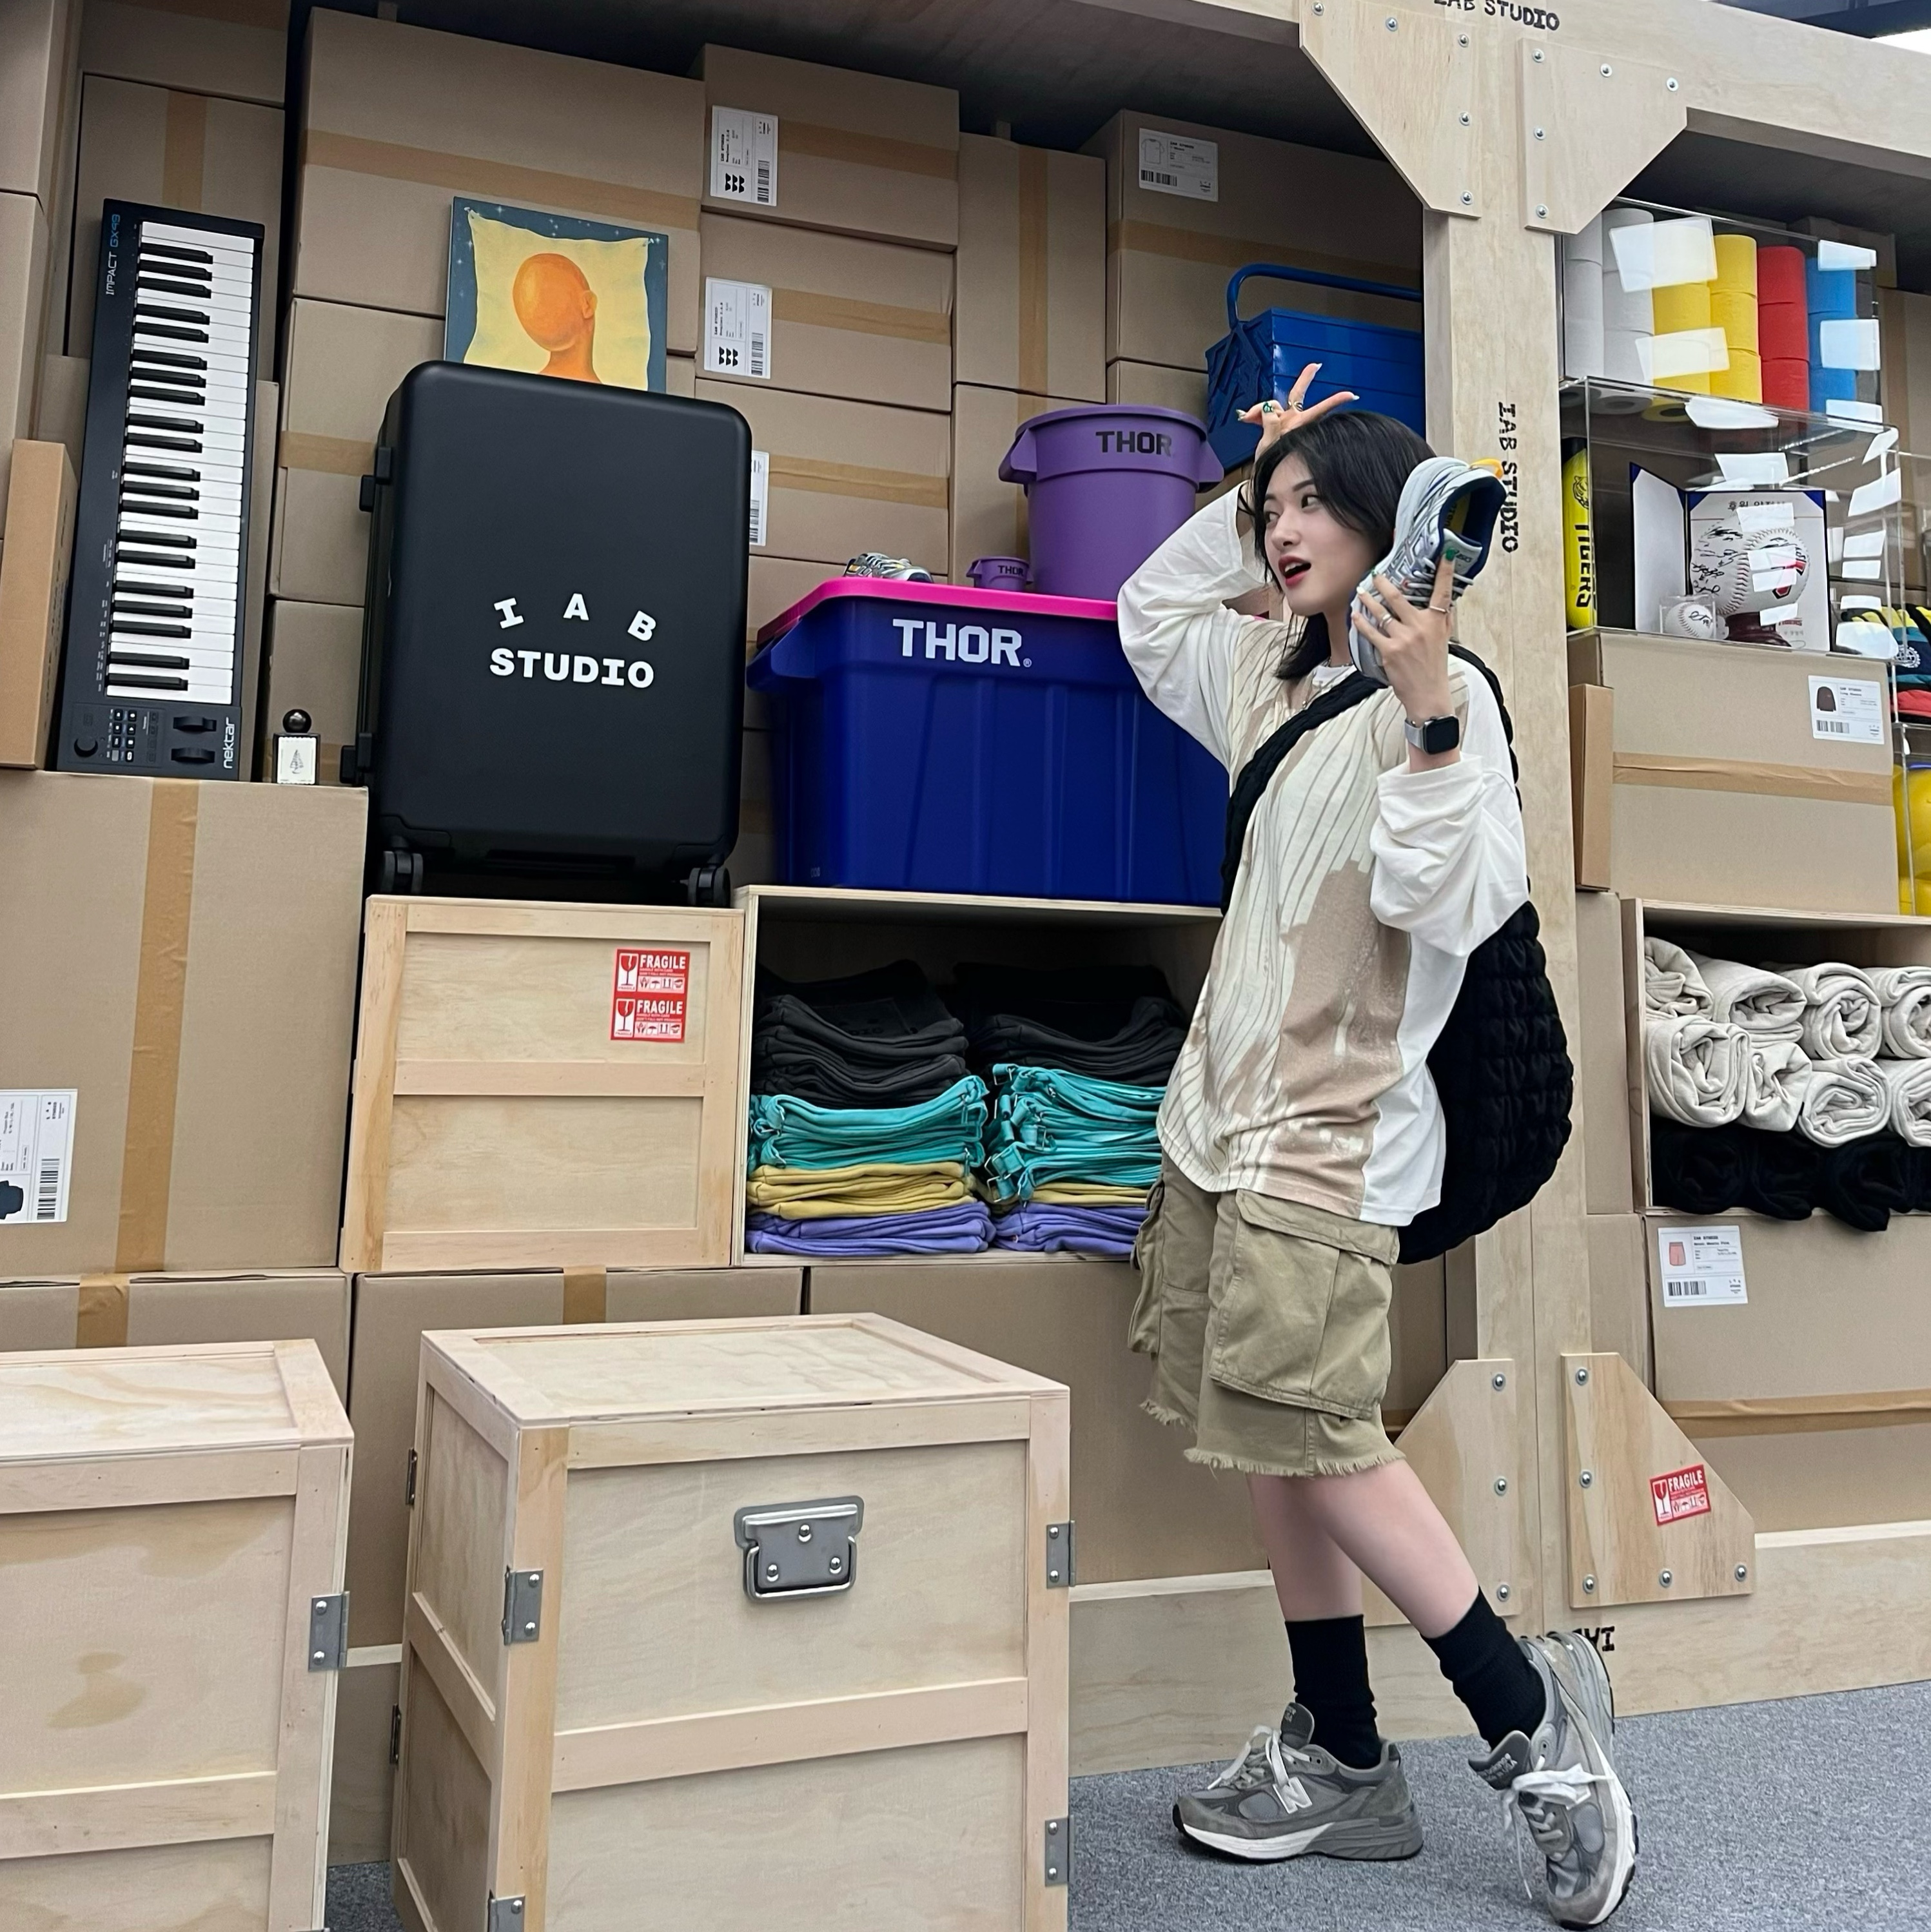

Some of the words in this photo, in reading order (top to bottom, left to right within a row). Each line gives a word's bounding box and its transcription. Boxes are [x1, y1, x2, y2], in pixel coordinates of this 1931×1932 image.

[1484, 0, 1560, 31] STUDIO
[110, 214, 121, 248] GX49
[106, 251, 117, 295] IMPACT
[1498, 401, 1517, 451] IAB
[1095, 430, 1172, 458] THOR
[1500, 460, 1518, 554] STUDIO
[997, 564, 1024, 578] THOR
[489, 647, 654, 688] STUDIO
[222, 716, 235, 769] nektar
[640, 954, 686, 970] FRAGILE
[636, 999, 683, 1015] FRAGILE
[1667, 1469, 1704, 1492] FRAGILE
